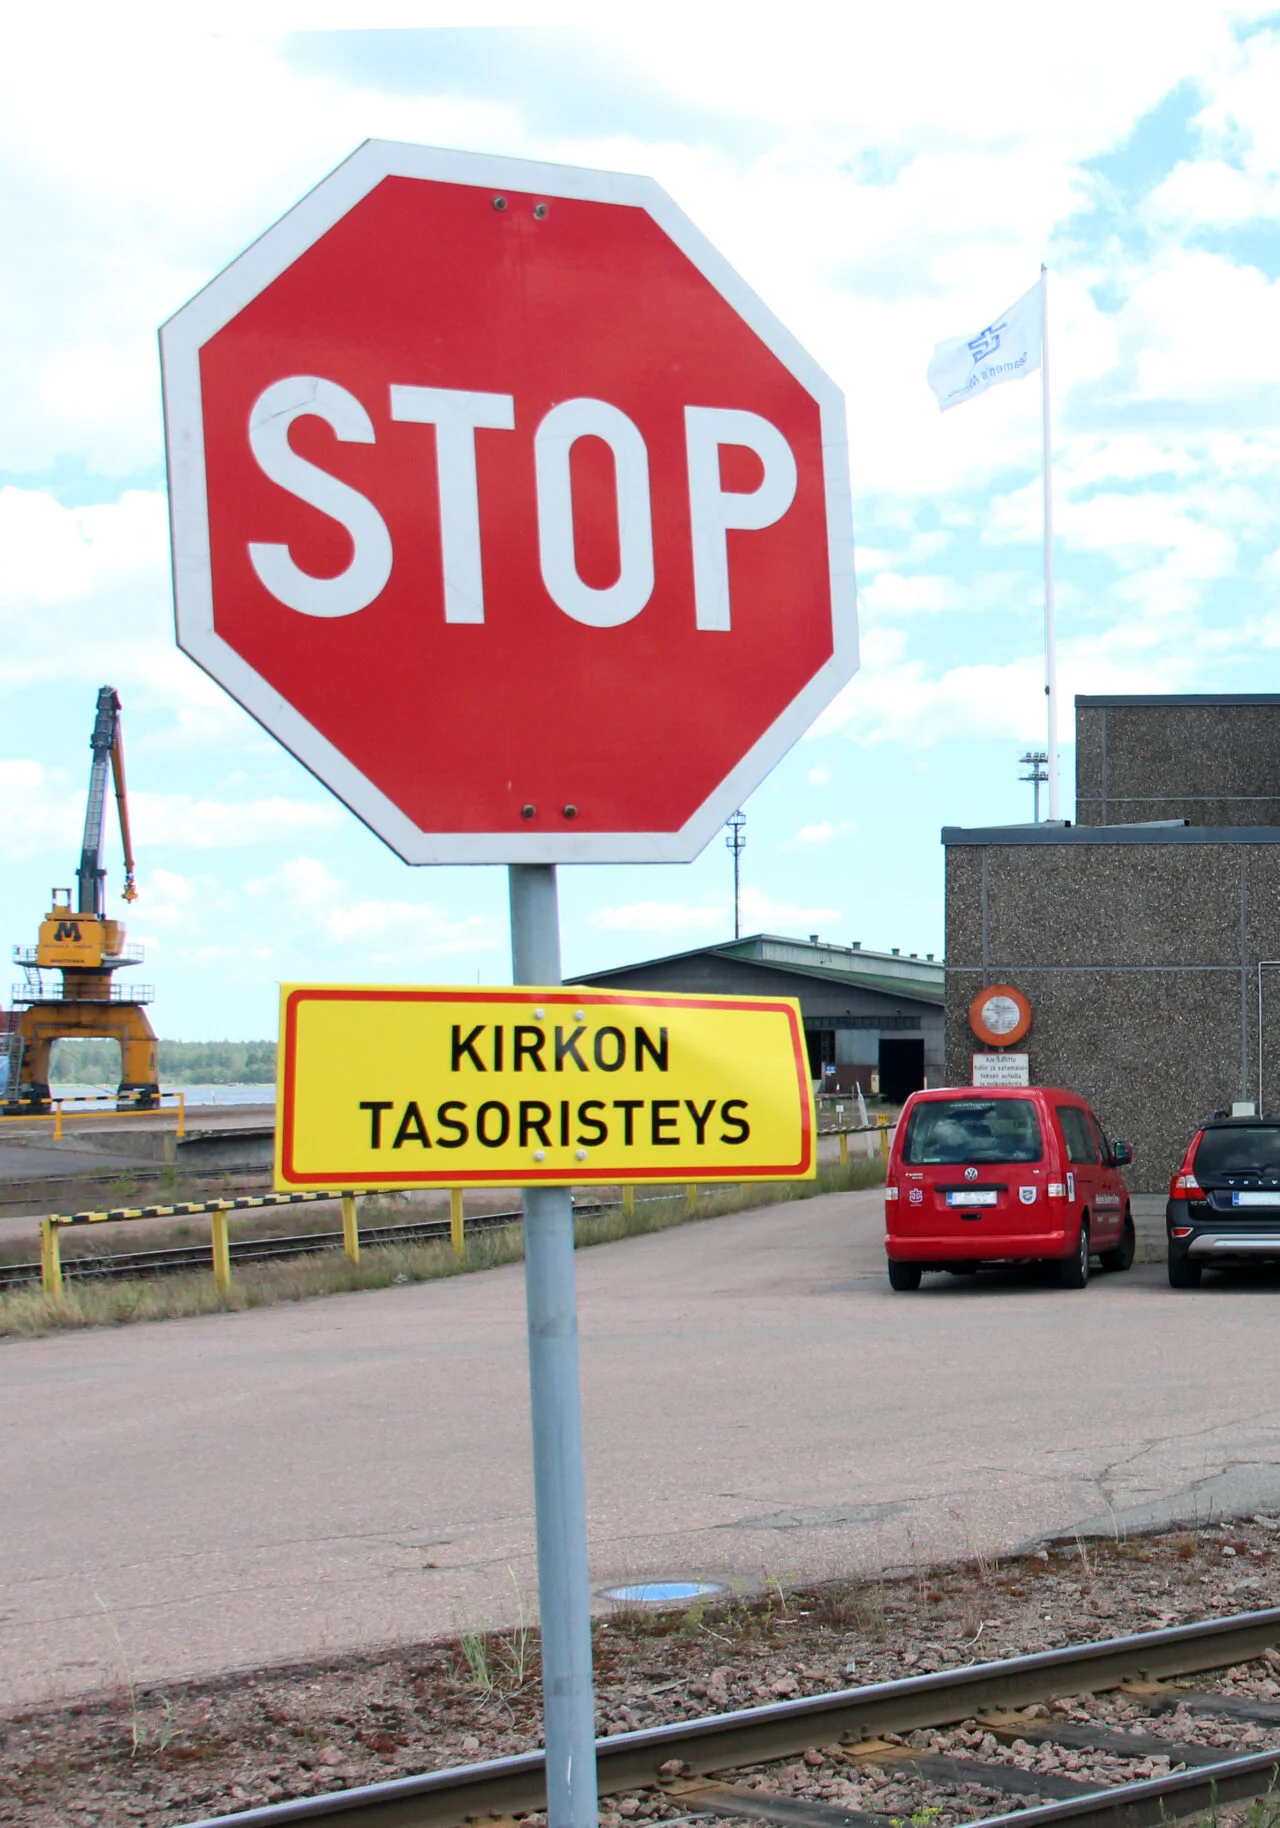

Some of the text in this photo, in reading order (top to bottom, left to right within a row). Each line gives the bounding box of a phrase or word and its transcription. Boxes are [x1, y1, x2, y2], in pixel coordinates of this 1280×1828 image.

[248, 375, 798, 631] STOP
[451, 1024, 669, 1073] KIRKON
[359, 1099, 751, 1149] TASORISTEYS
